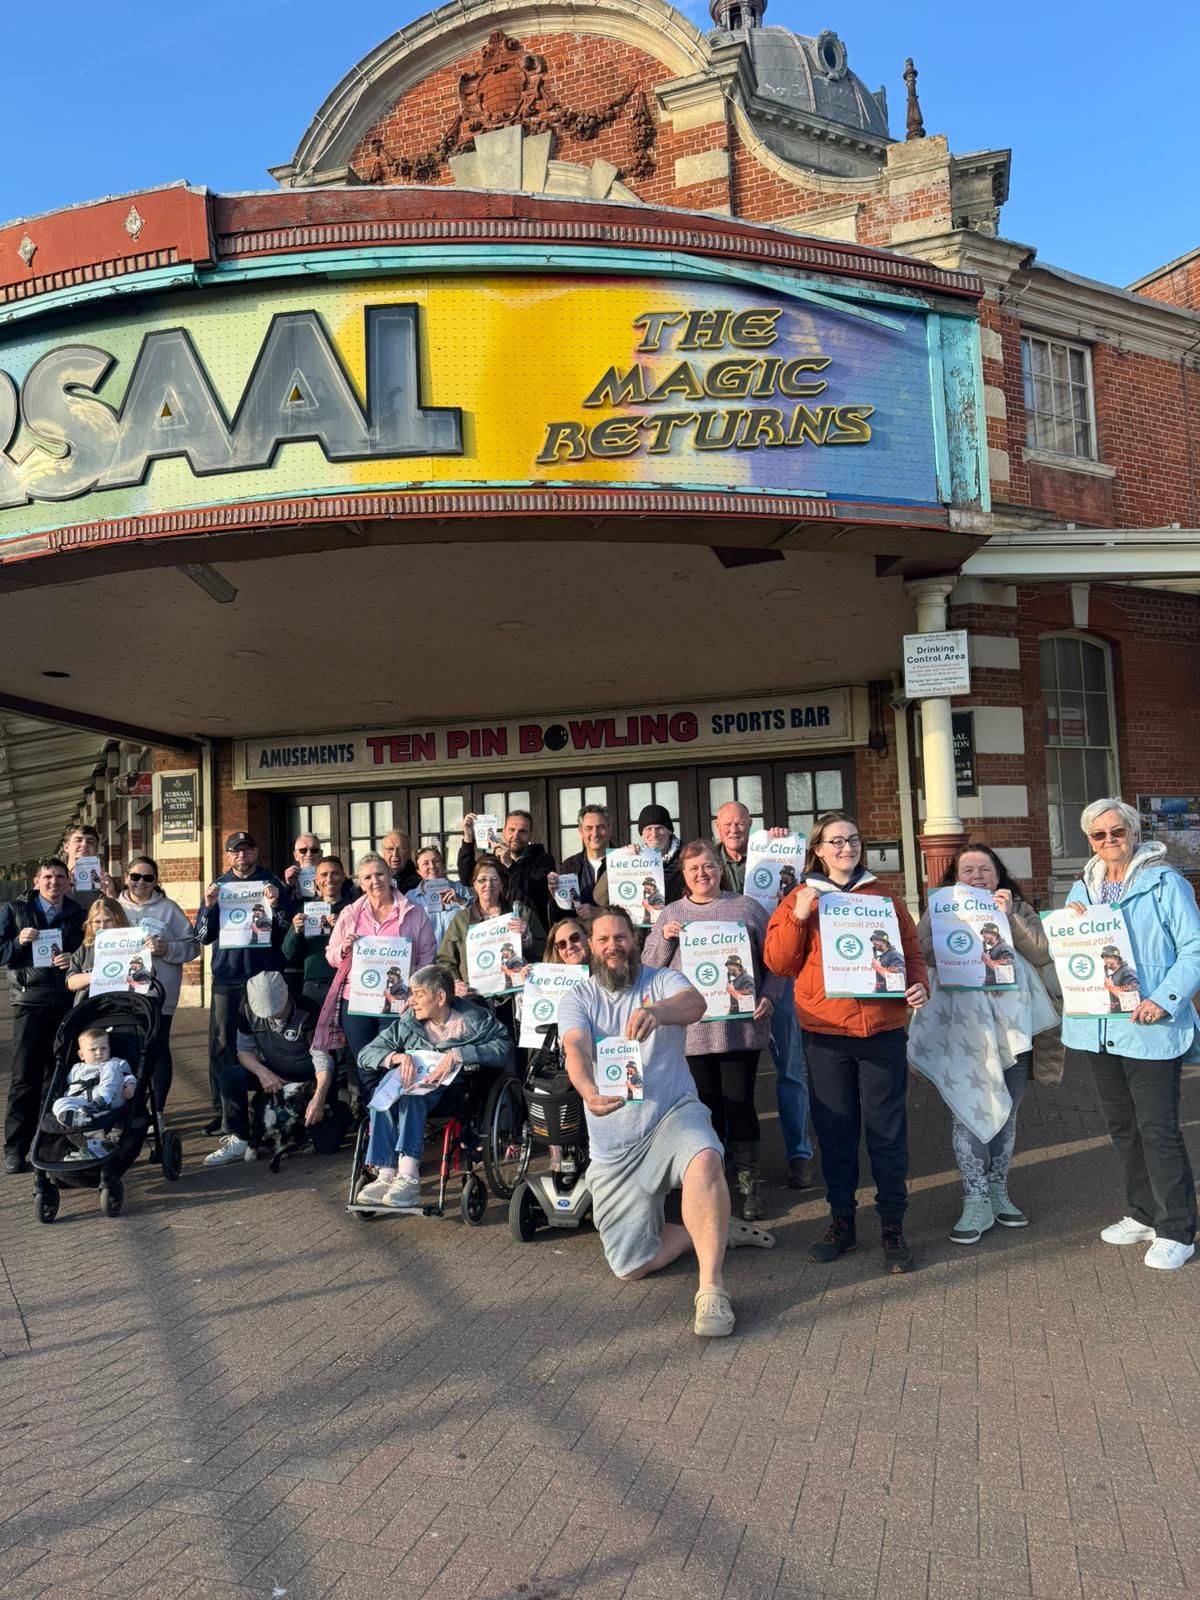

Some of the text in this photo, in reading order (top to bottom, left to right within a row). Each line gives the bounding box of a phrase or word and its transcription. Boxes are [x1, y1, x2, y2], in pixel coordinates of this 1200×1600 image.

[632, 308, 783, 352] THE
[583, 356, 832, 407] MAGIC
[0, 302, 463, 508] SAAL
[535, 405, 874, 463] RETURNS
[917, 645, 955, 655] Drinking
[907, 653, 966, 664] Control Area
[259, 706, 830, 769] AMUSEMENTS TEN PIN BOWLING SPORTS BAR
[750, 842, 803, 855] Lee Clark
[610, 858, 660, 868] Lee Clark
[221, 892, 238, 900] Lee
[824, 904, 892, 918] Lee Clark
[934, 902, 960, 913] Lee
[470, 926, 510, 940] Lee Cla
[1050, 918, 1122, 937] Lee Clark
[98, 940, 117, 949] Lee
[684, 932, 746, 947] Lee Clark
[1062, 936, 1114, 948] Kursaal 2026
[356, 946, 409, 958] Lee Clark
[529, 974, 551, 986] Lee
[1086, 984, 1094, 992] of
[1094, 984, 1106, 992] the
